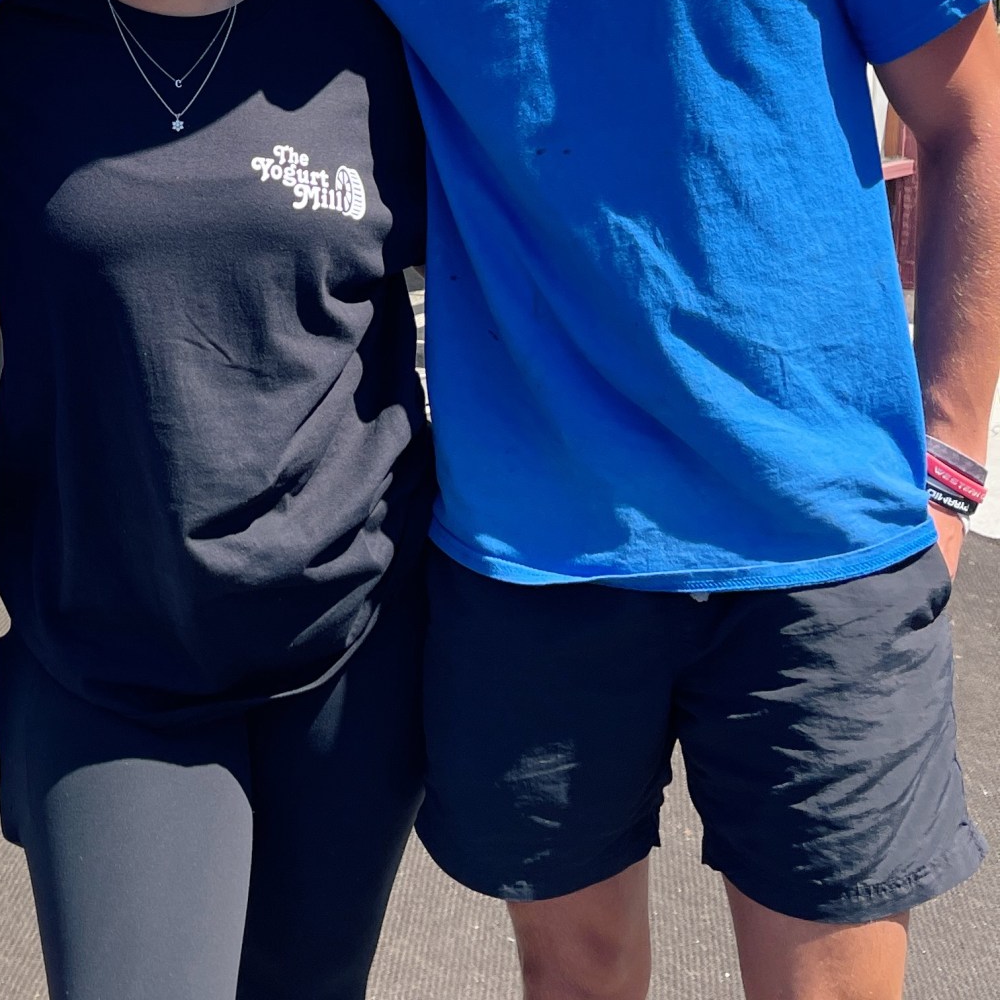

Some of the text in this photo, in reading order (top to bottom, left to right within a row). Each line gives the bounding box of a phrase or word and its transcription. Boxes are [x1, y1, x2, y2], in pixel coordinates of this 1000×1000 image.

[272, 144, 310, 167] The
[250, 156, 330, 188] Yogurt
[292, 183, 343, 212] Mill
